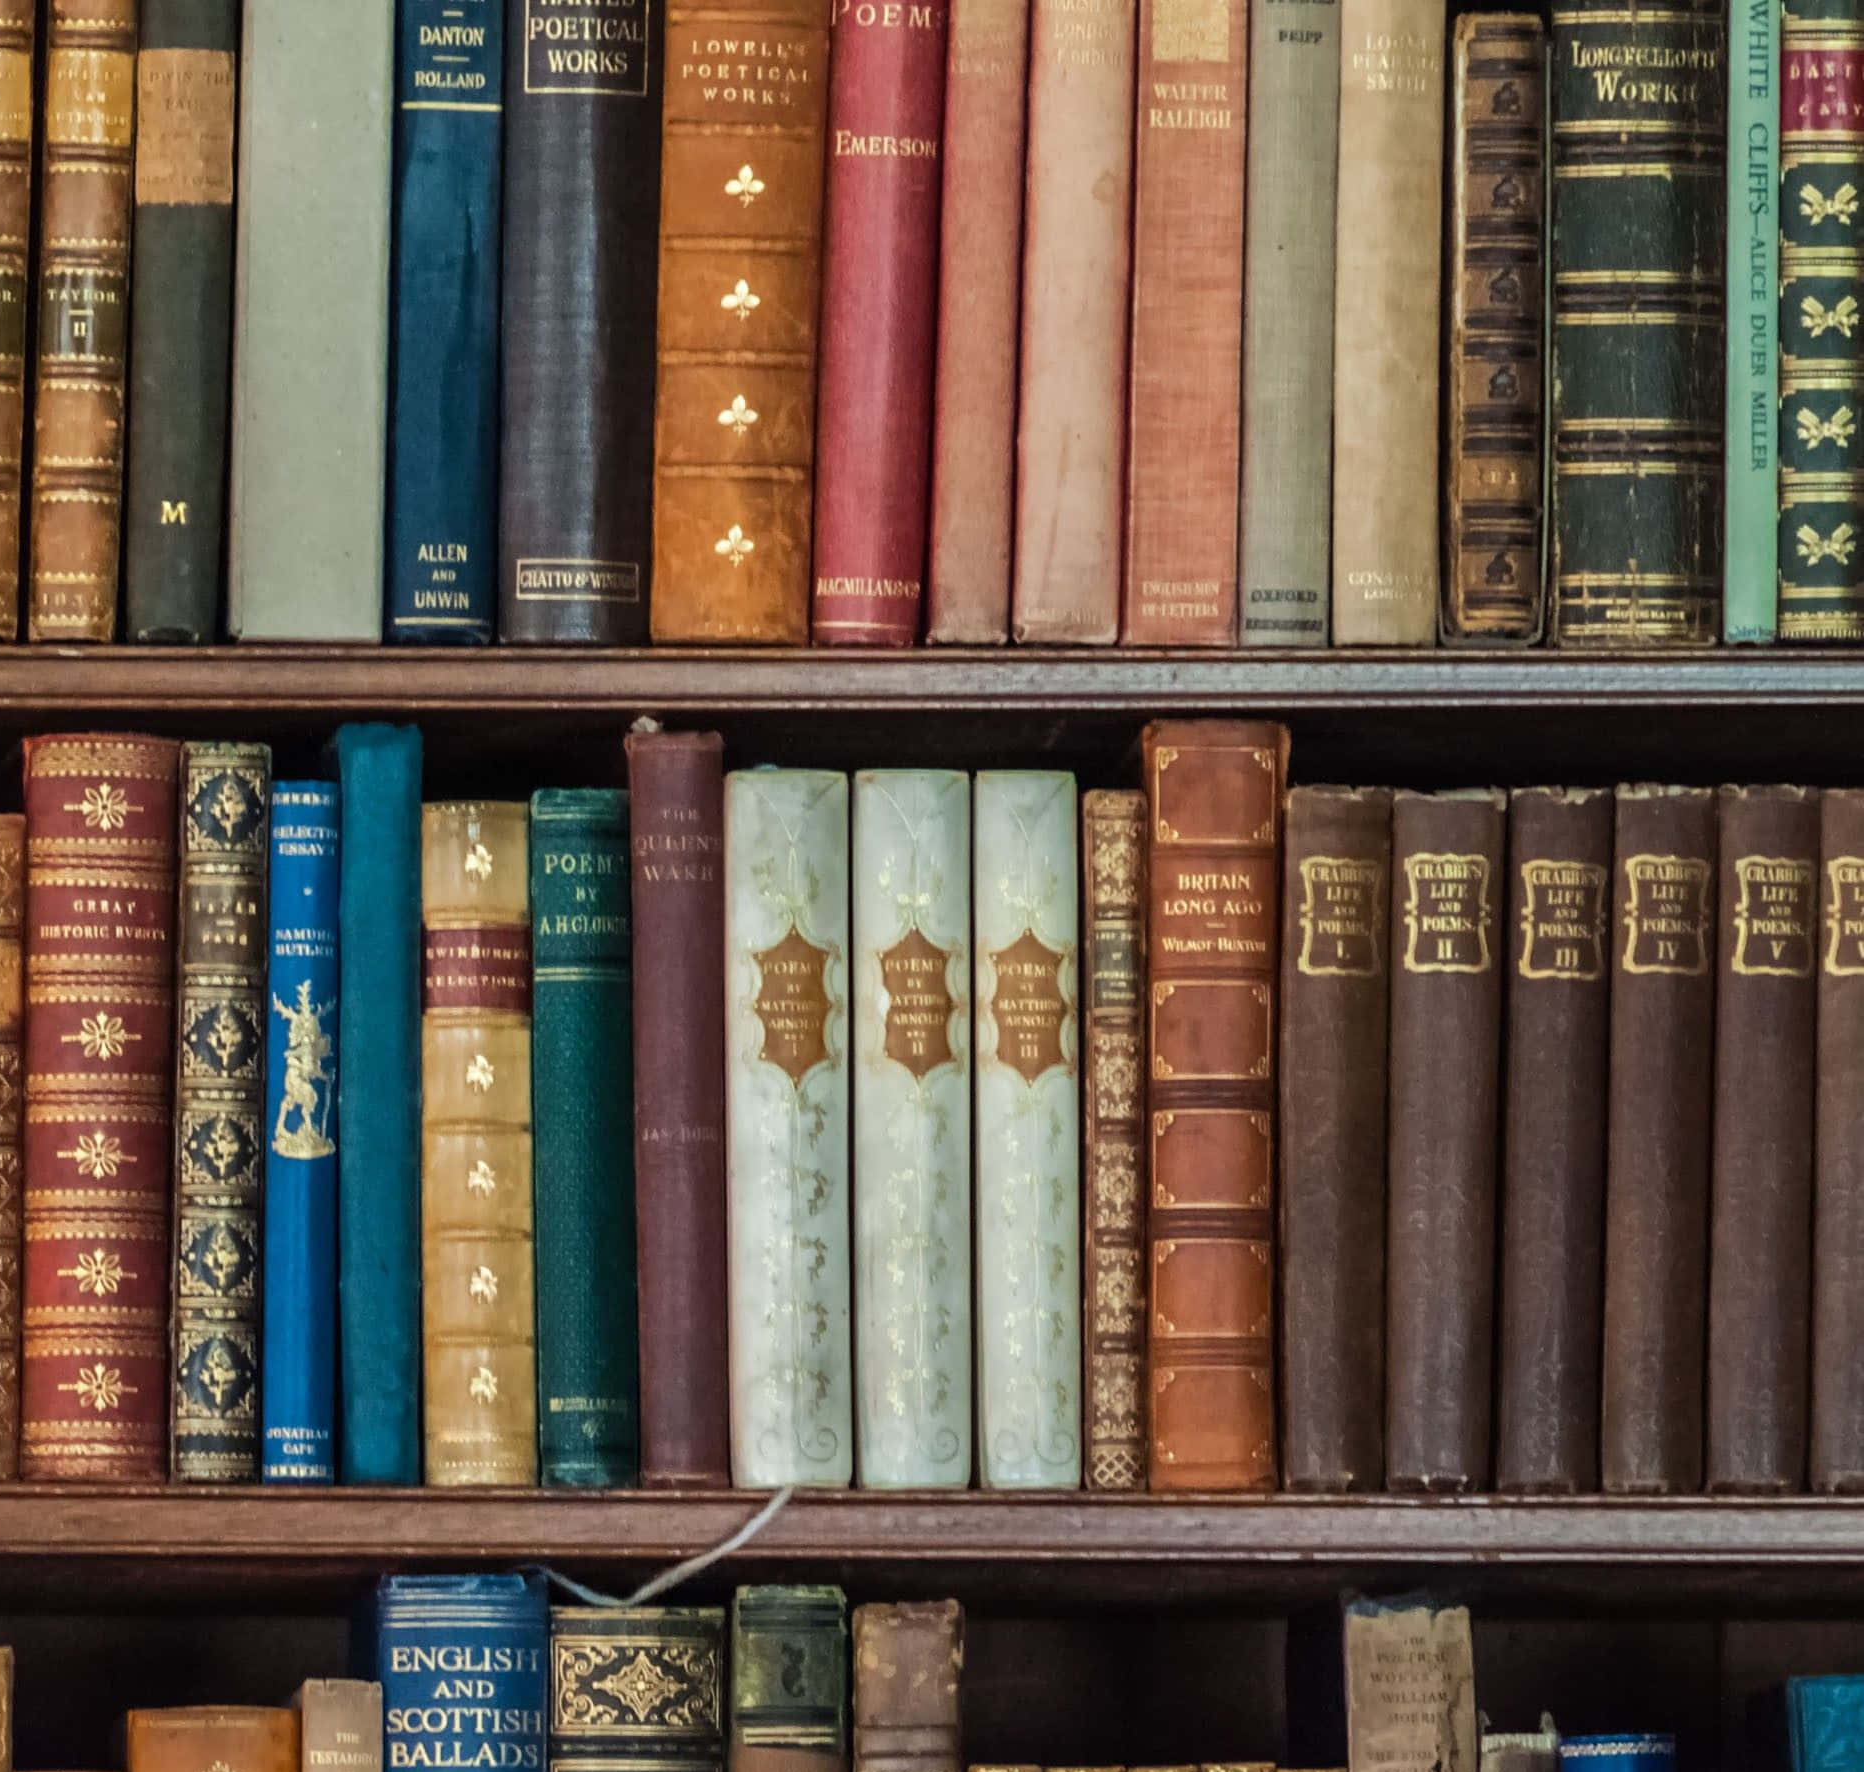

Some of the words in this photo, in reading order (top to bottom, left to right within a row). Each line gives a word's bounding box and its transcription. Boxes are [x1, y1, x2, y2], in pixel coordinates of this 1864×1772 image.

[419, 26, 484, 47] DANTON
[529, 16, 642, 42] POETICAL
[547, 47, 627, 74] WORKS
[414, 69, 485, 89] ROLLAND
[1149, 107, 1230, 129] RALEIGH
[835, 129, 936, 159] EMERSON
[1750, 313, 1767, 377] DUER
[1750, 391, 1767, 472] MILLER
[418, 542, 467, 562] ALLEN
[414, 589, 469, 610] UNWIN
[1177, 871, 1252, 893] BRITAIN
[1429, 886, 1467, 901] LIFE
[1162, 897, 1215, 918] LONG
[1221, 897, 1264, 918] AGO
[40, 924, 106, 940] HISTORIC
[391, 1647, 537, 1673] ENGLISH
[434, 1680, 494, 1697] AND
[388, 1707, 540, 1734] SCOTTISH
[390, 1741, 537, 1768] BALLADS
